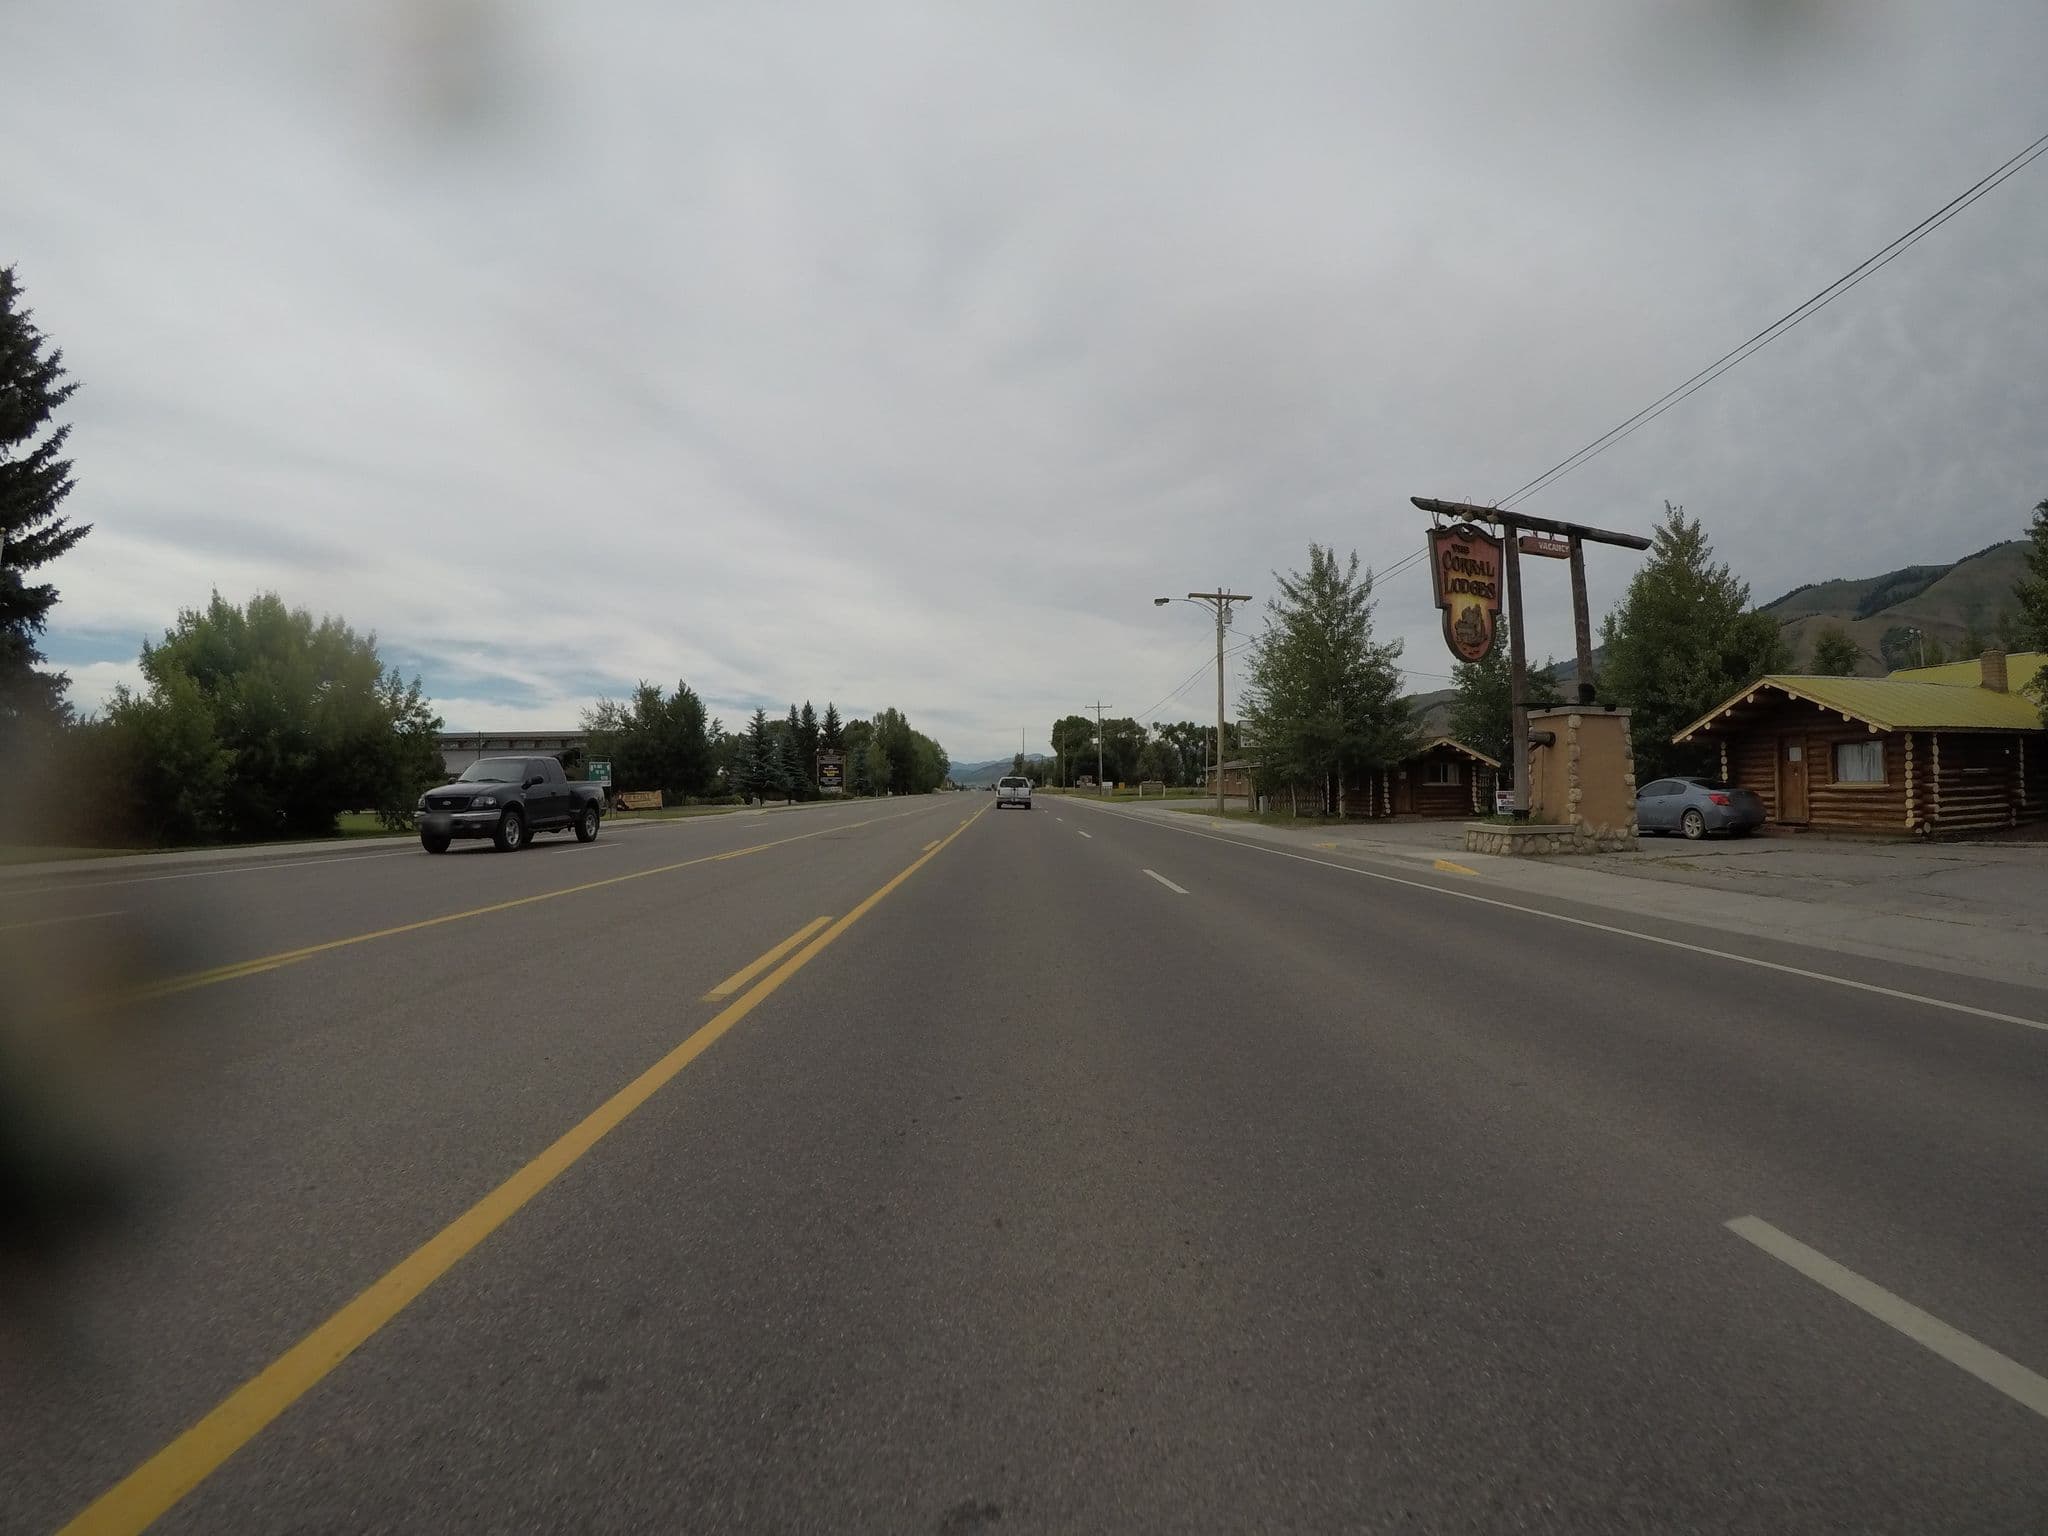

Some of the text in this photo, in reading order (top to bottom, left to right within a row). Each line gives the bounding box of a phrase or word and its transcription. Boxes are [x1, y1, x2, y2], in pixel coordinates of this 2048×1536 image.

[1538, 541, 1569, 553] VACANCY
[1442, 550, 1495, 577] CORRAL
[1443, 571, 1496, 599] LODGES
